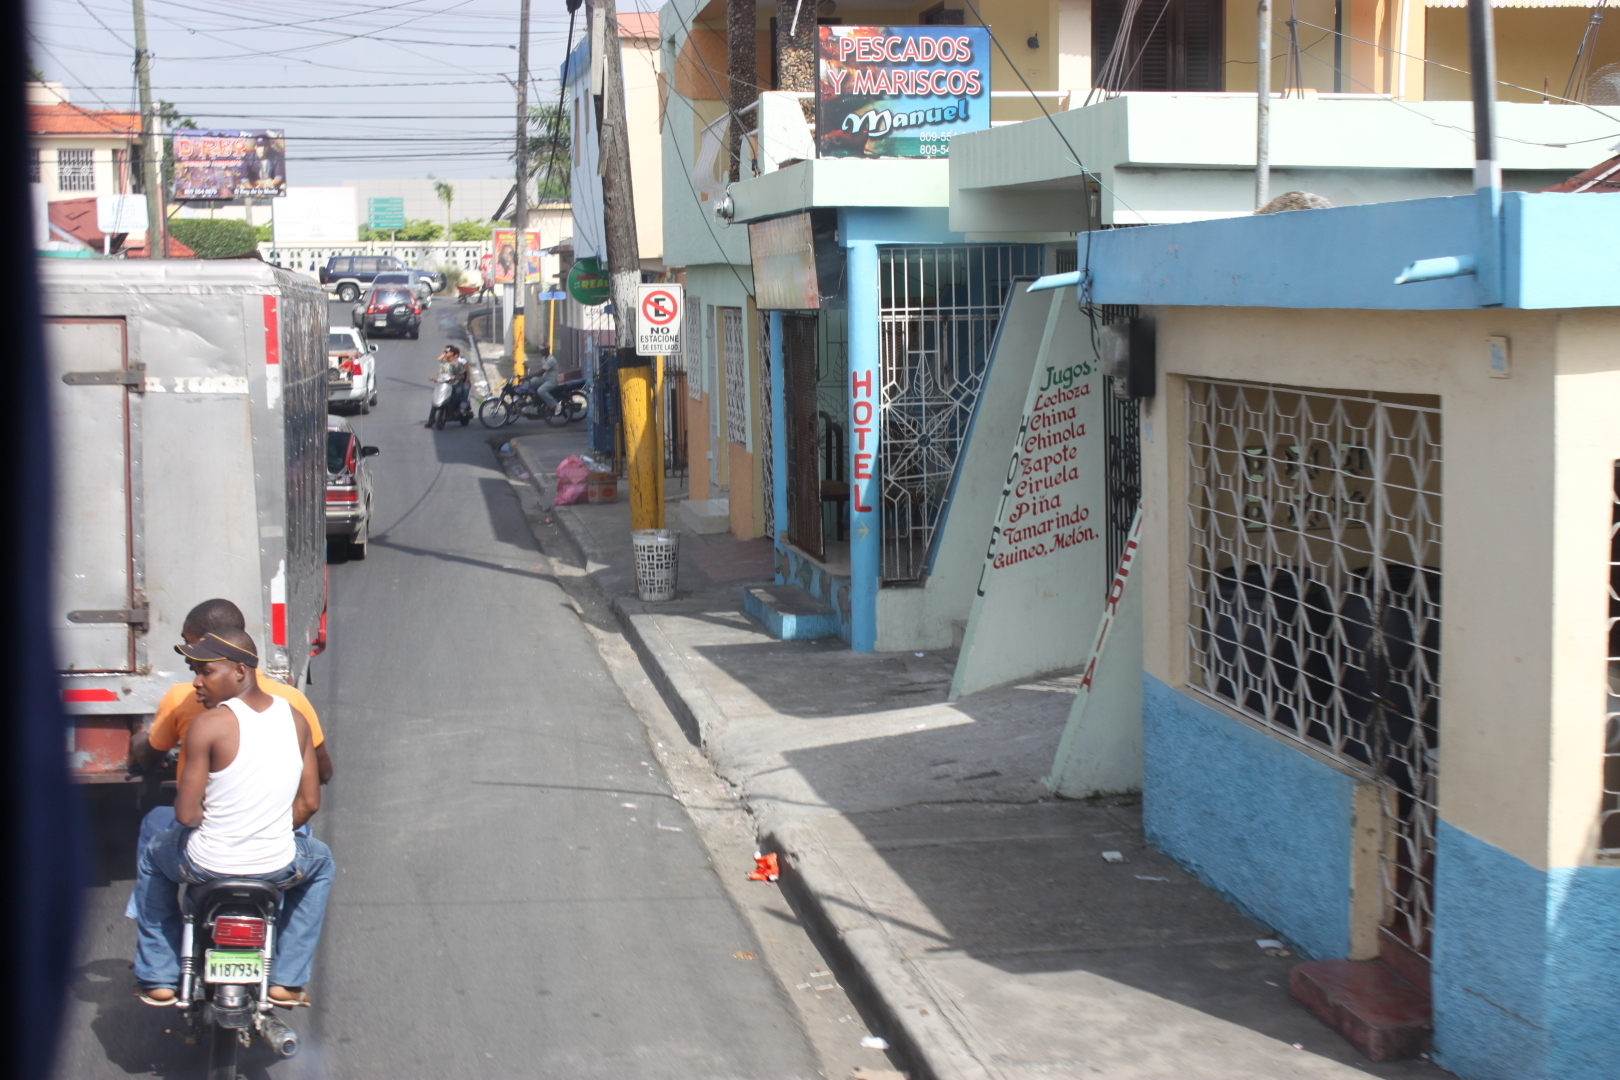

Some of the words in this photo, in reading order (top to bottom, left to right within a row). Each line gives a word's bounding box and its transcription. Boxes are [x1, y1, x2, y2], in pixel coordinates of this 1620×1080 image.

[839, 36, 971, 63] PESCADOS
[828, 69, 848, 95] Y
[853, 69, 981, 96] MARISCOS
[841, 98, 969, 137] Manuel
[640, 335, 679, 343] ESTACIONE
[651, 326, 670, 335] NO
[1040, 359, 1098, 392] Jugos:
[1033, 383, 1091, 412] Lechoza
[1030, 407, 1077, 432] China
[852, 369, 873, 513] HOTEL
[1024, 421, 1086, 454] Chinola
[1020, 444, 1078, 476] Zapote
[1015, 465, 1079, 498] Ciruela
[977, 414, 1030, 597] HOTEL
[1009, 493, 1062, 523] Piña
[1002, 504, 1090, 545] Tamarindo
[993, 543, 1049, 570] Guineo,
[1049, 526, 1100, 553] Melón.
[210, 962, 260, 977] N187934
